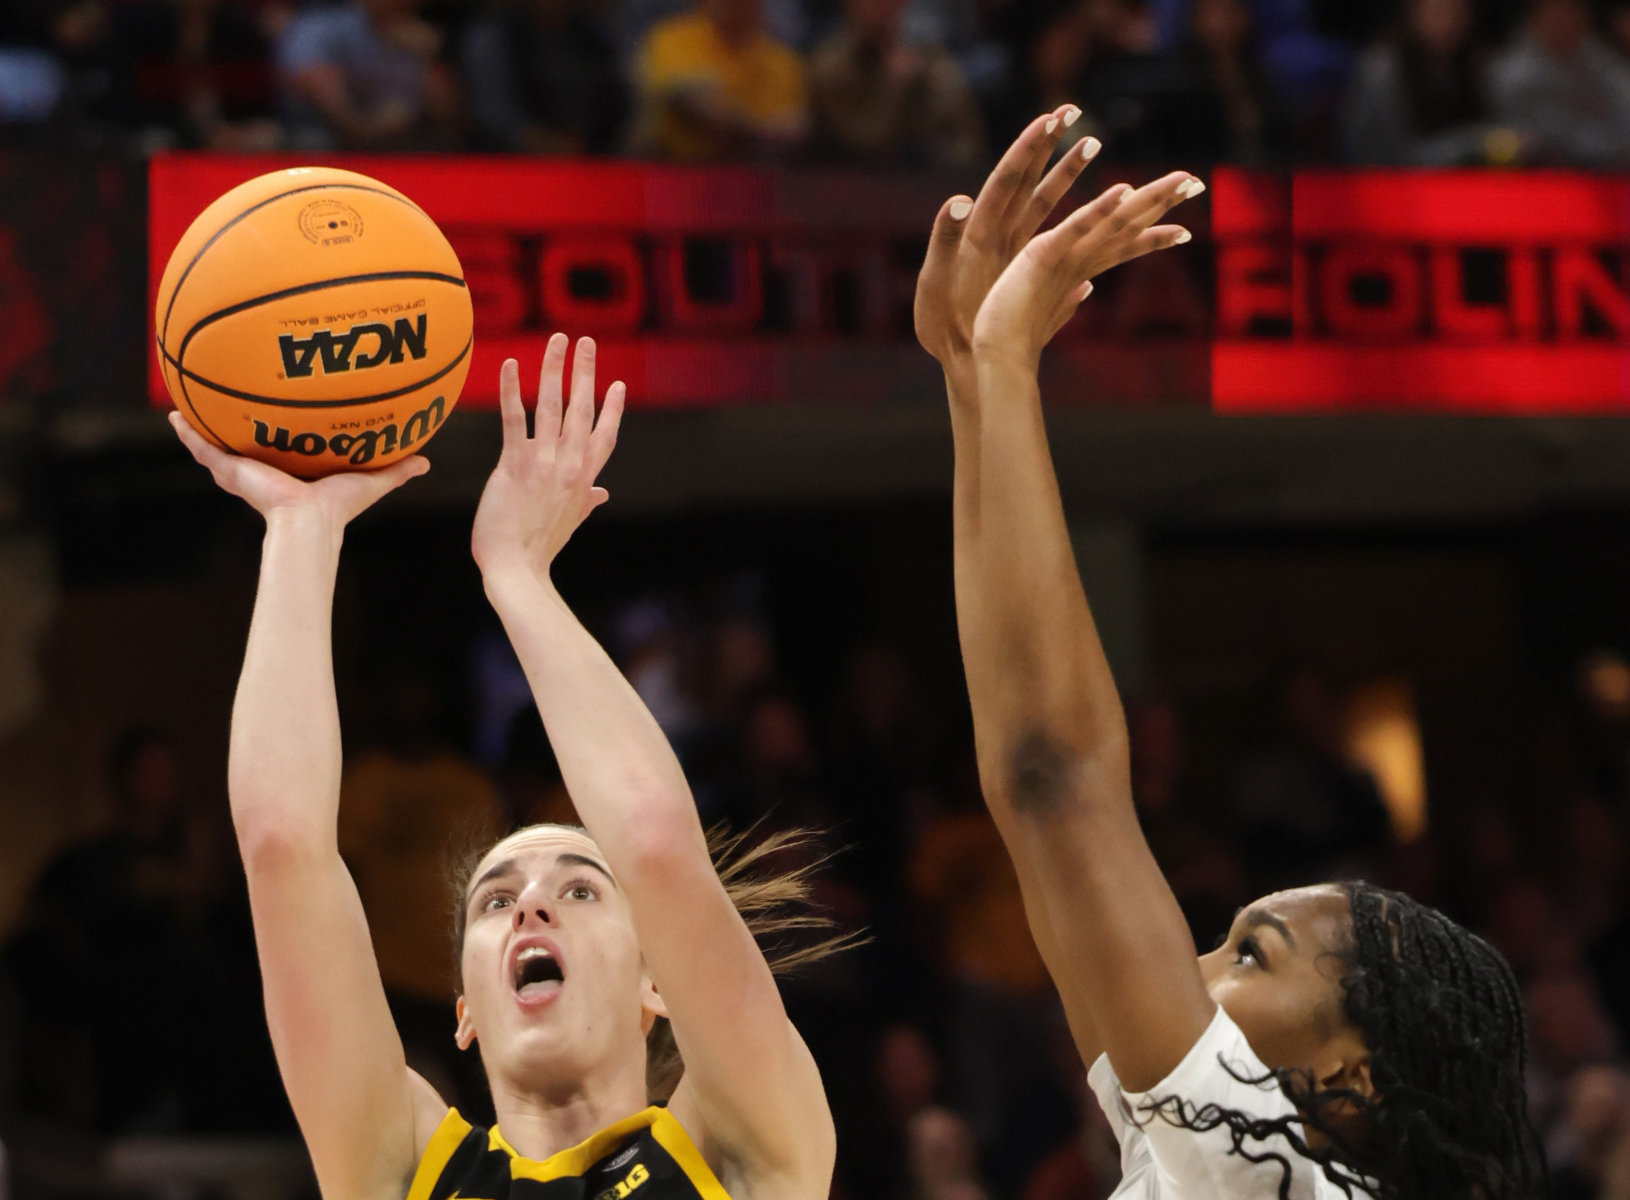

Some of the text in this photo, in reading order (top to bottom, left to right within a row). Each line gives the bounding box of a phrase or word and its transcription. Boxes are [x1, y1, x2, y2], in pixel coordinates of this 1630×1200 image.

[278, 299, 426, 329] OFFICIAL GAME BALL
[278, 313, 428, 380] NCAA
[252, 395, 446, 465] Wilson
[329, 412, 395, 431] EVO NXT
